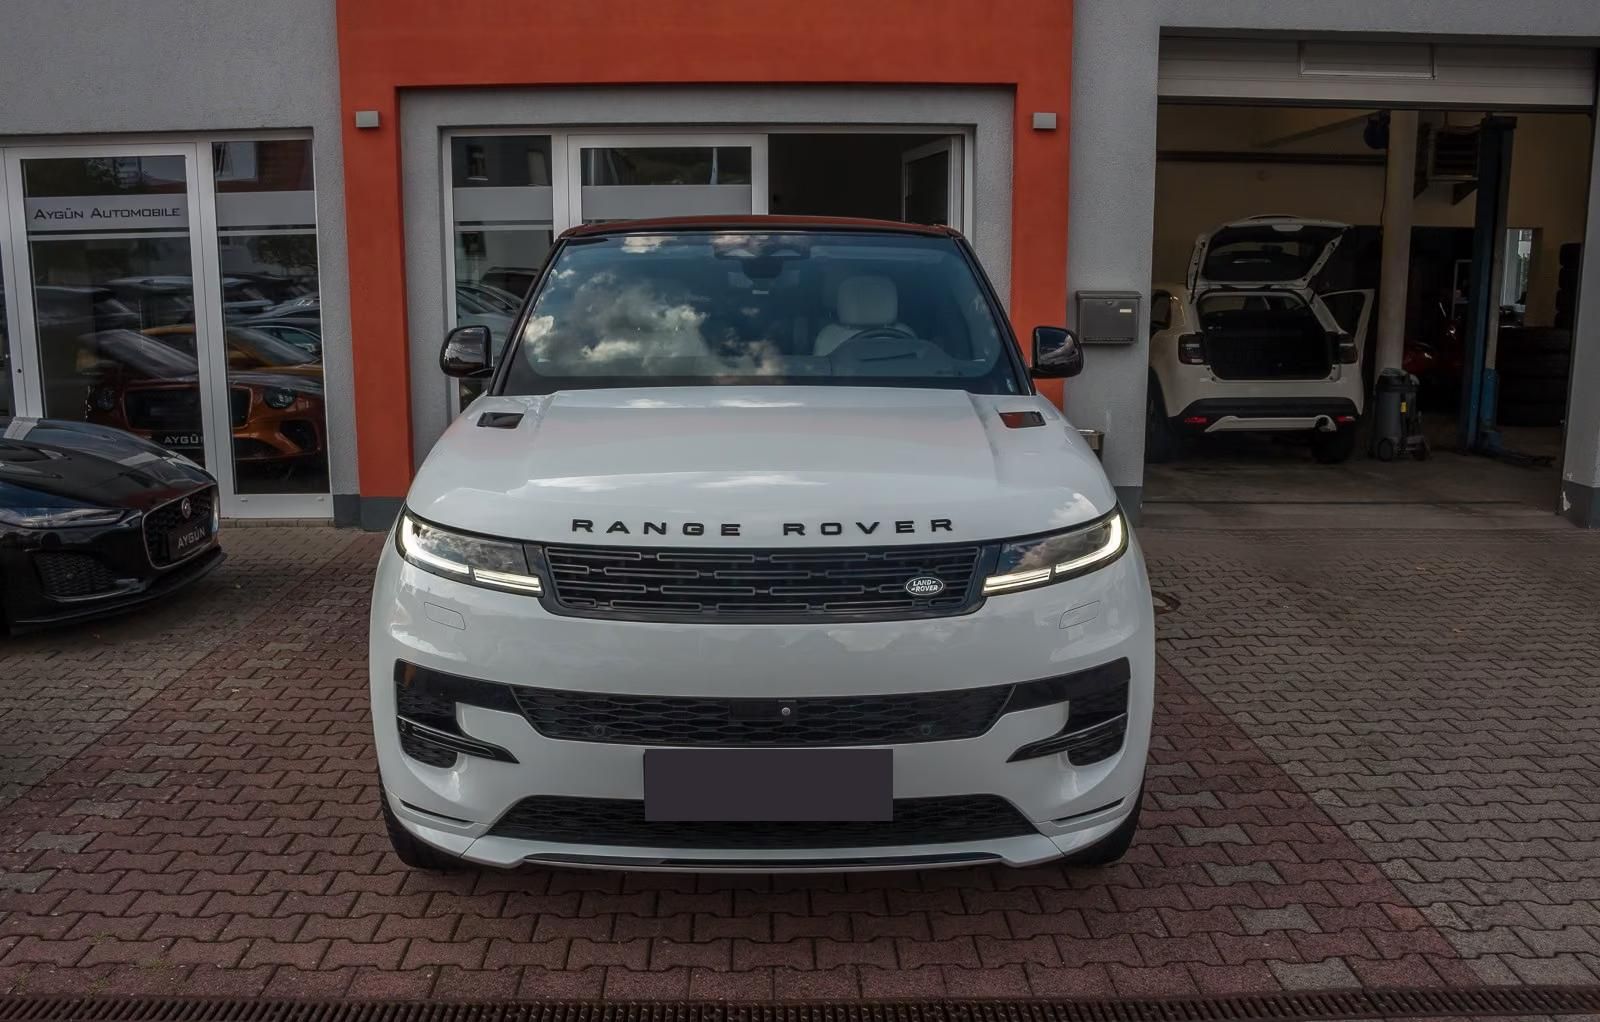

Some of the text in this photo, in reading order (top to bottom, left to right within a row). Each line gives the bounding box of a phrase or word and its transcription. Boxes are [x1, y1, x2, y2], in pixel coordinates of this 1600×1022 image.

[33, 207, 181, 220] AYGÜN AUTOMOBILE
[571, 518, 953, 536] RANGE ROVER
[177, 526, 206, 549] AYGÜN
